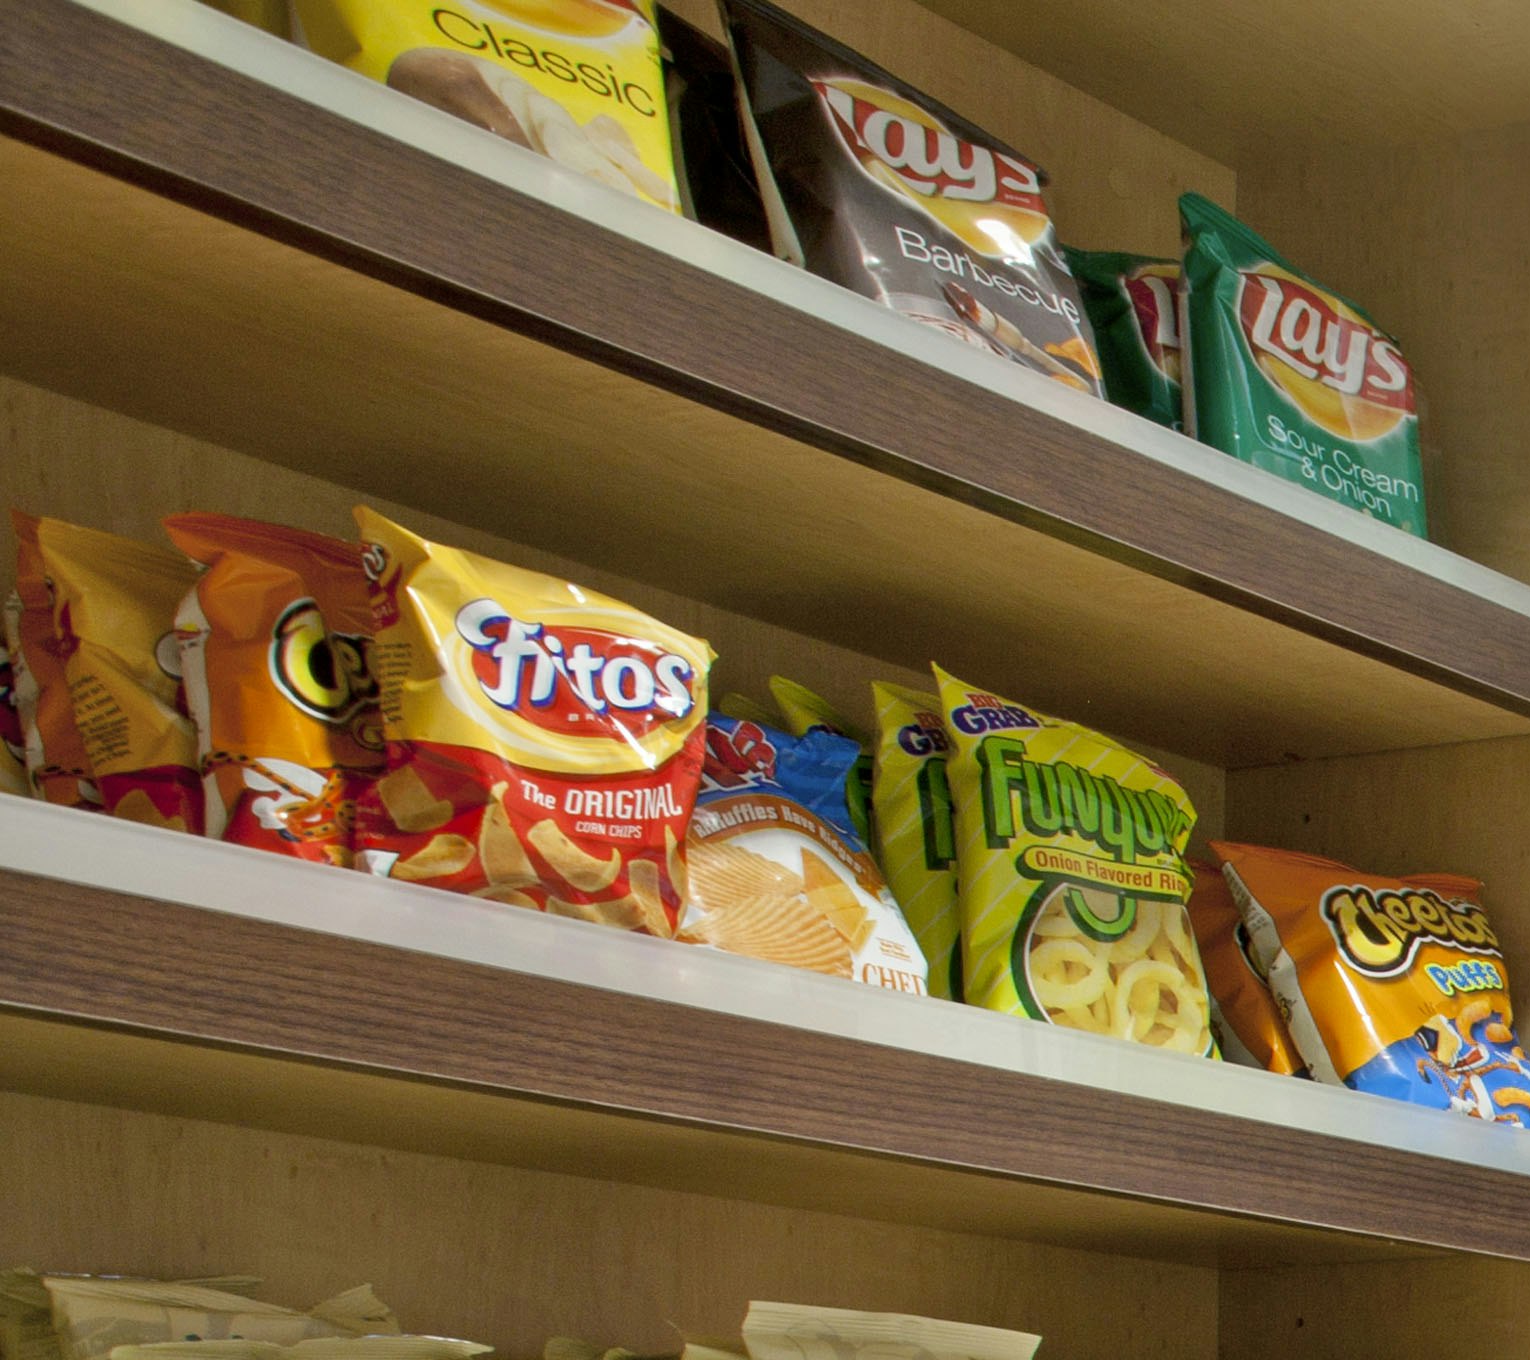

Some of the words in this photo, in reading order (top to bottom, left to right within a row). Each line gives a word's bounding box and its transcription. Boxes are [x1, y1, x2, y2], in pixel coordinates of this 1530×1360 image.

[432, 7, 656, 118] Classic
[894, 226, 1081, 325] Barbecue
[1247, 272, 1410, 395] Lay's
[1266, 414, 1327, 462] Sour
[1333, 449, 1419, 503] Cream
[1301, 457, 1318, 481] &
[1321, 463, 1392, 518] Onion
[951, 703, 1037, 735] GRAB
[521, 780, 556, 810] The
[565, 783, 683, 820] ORIGINAL
[575, 820, 605, 836] CORN
[608, 823, 642, 839] CHIPS
[1035, 850, 1083, 873] Onion
[1086, 858, 1154, 889] Flavored
